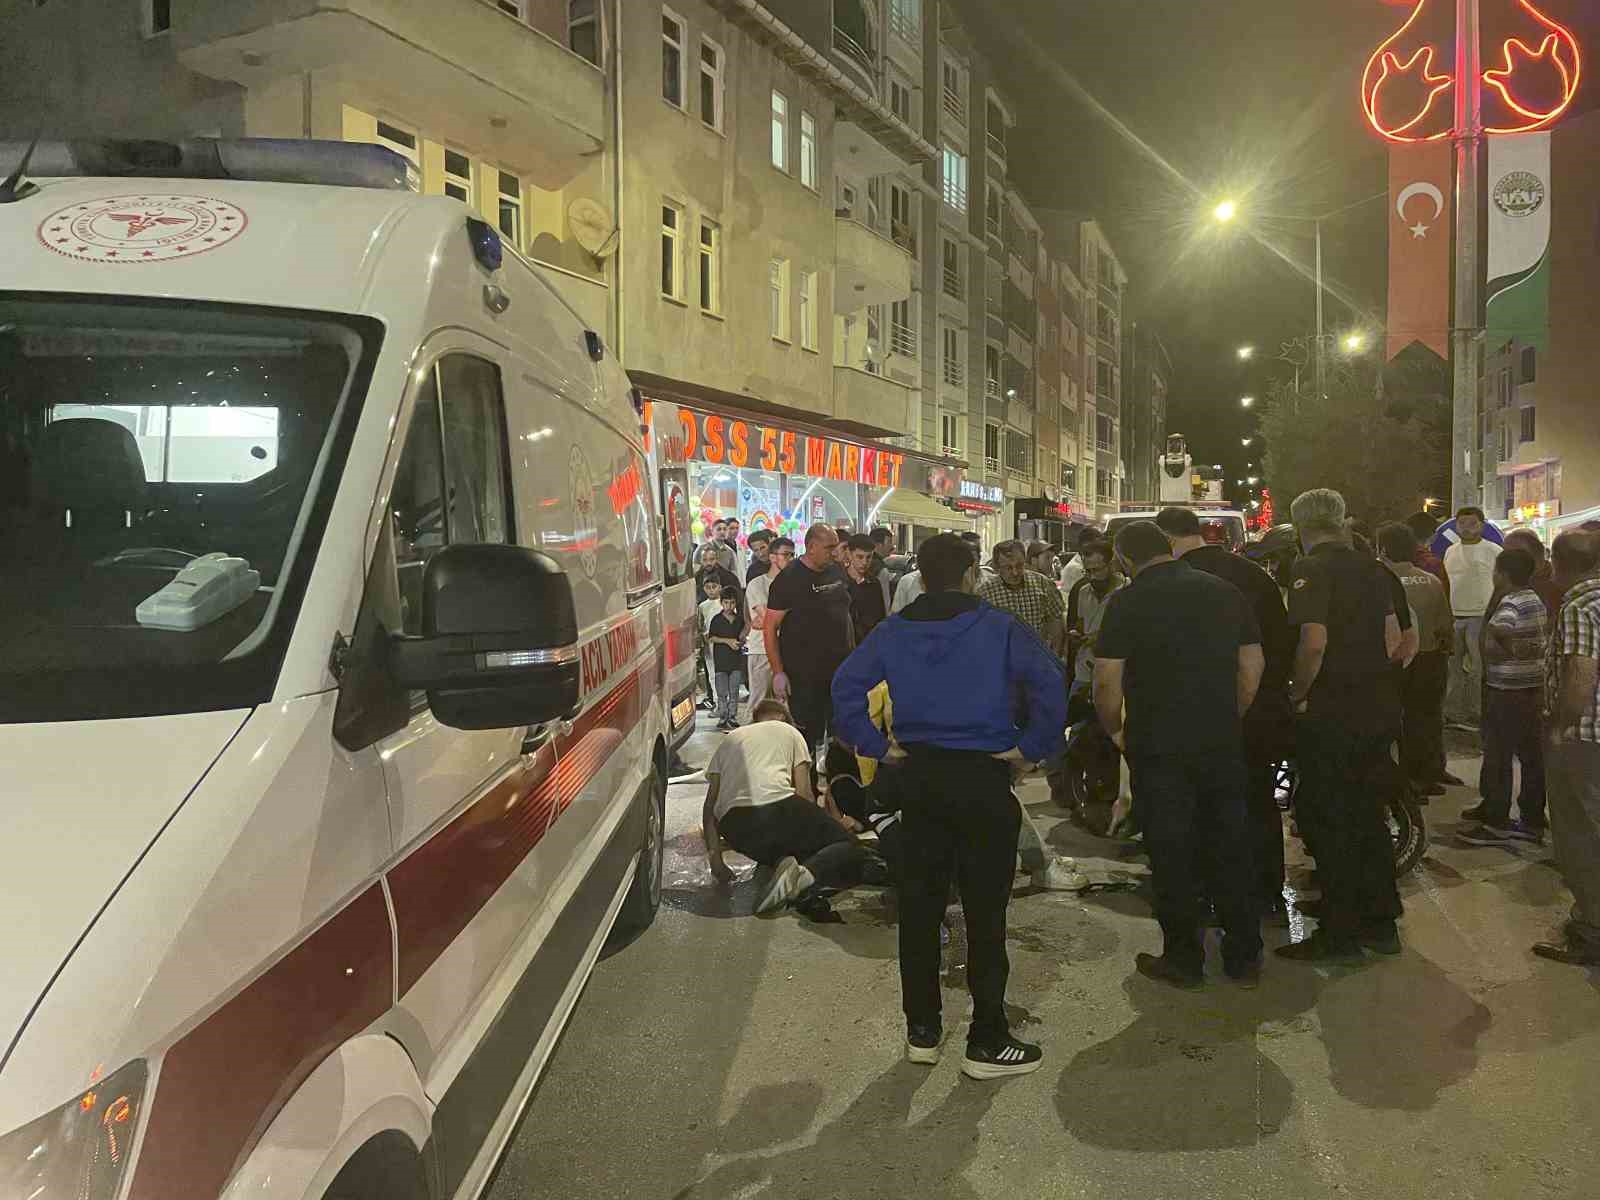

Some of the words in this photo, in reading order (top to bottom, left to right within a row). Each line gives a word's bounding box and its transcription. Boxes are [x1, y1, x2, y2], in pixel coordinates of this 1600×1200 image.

[643, 400, 748, 467] OSS
[760, 427, 796, 473] 55
[806, 436, 903, 488] MARKET
